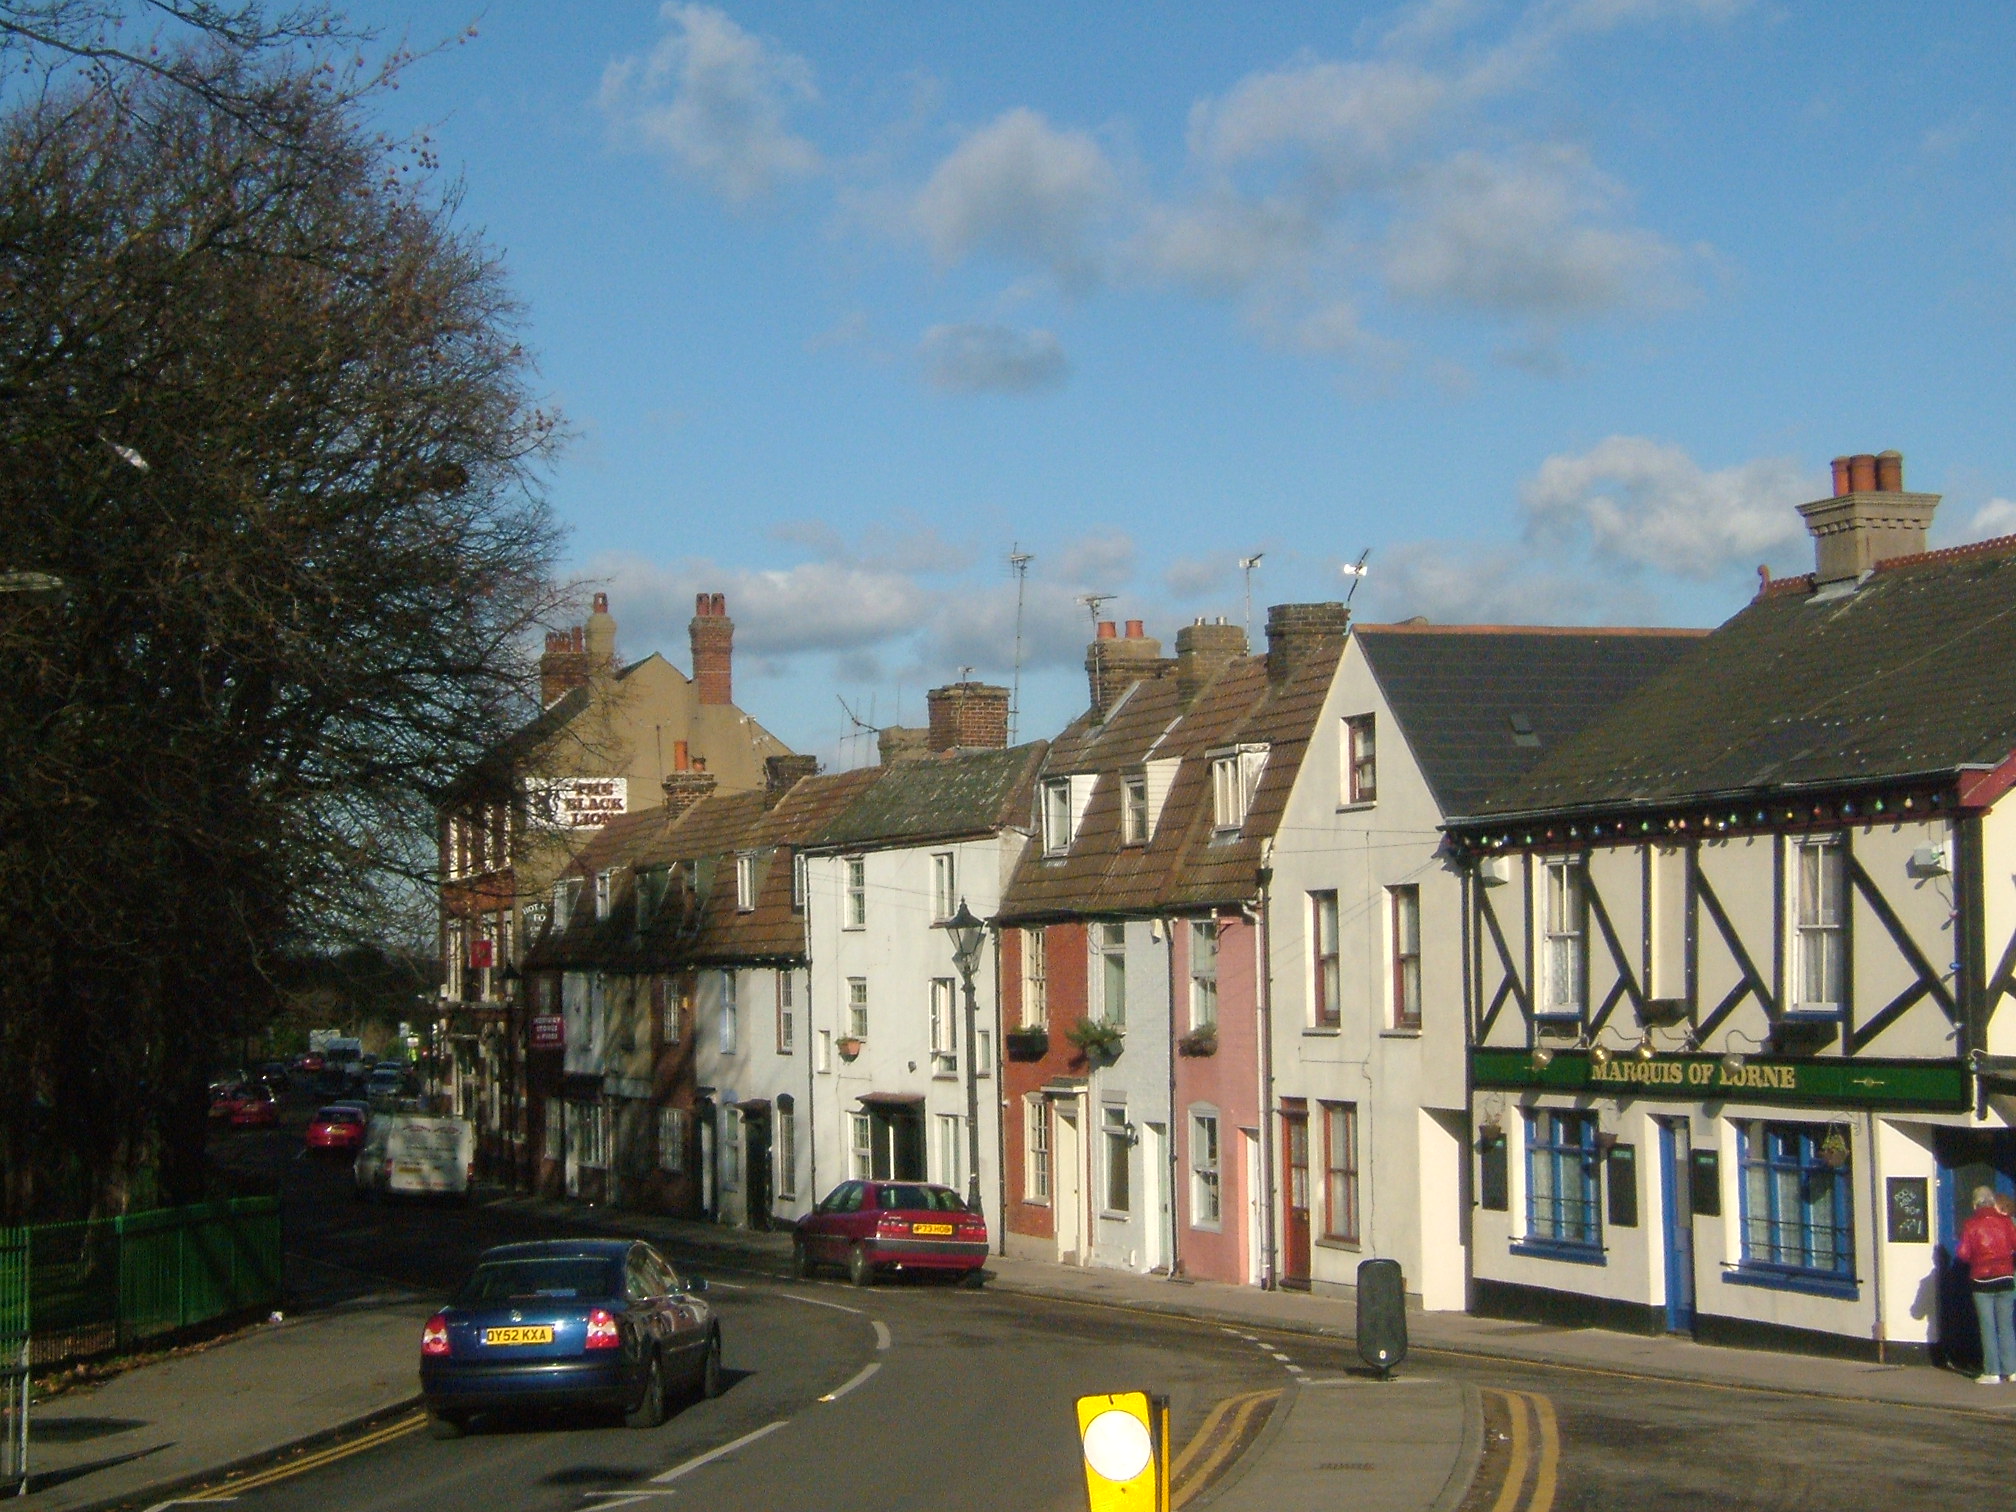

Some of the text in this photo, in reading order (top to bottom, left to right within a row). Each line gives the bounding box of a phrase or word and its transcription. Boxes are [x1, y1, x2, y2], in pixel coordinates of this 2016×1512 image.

[573, 783, 613, 796] THE
[565, 798, 624, 811] BLACK
[1591, 1060, 1796, 1089] MARQUIS OF LORNE
[522, 1328, 547, 1341] KXA
